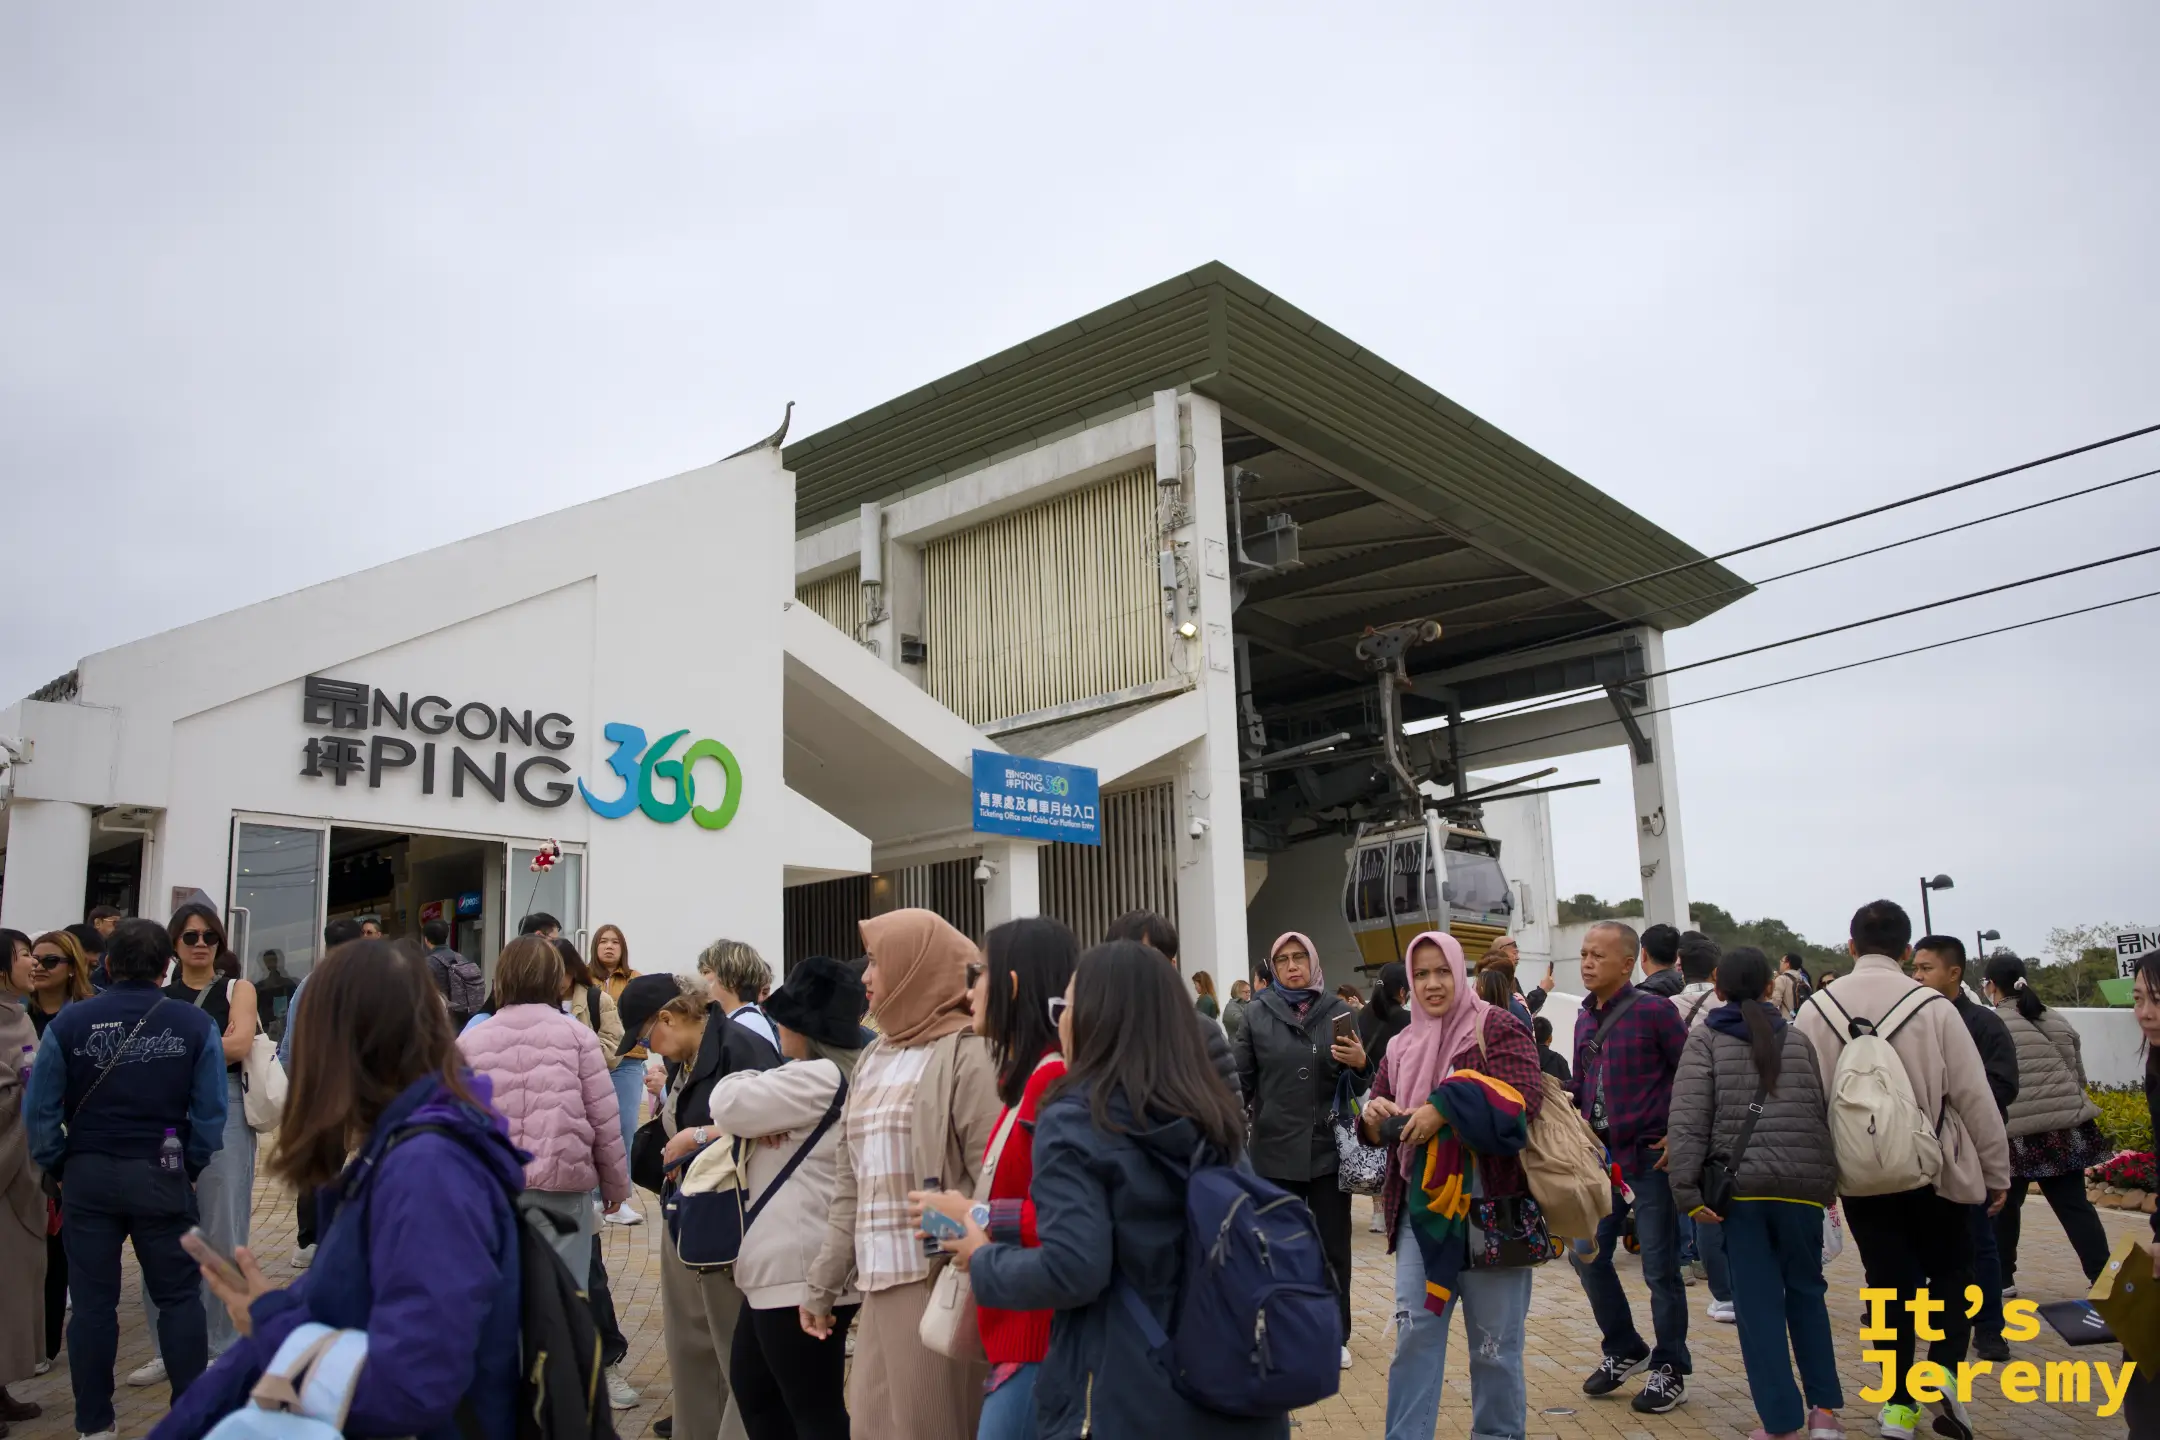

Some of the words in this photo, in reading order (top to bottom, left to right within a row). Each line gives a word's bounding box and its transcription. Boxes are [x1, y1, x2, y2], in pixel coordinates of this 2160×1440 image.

[372, 687, 575, 751] NGONG
[369, 735, 575, 808] PING
[578, 722, 743, 830] 360
[1014, 772, 1043, 782] NGONG
[1014, 779, 1043, 792] PING
[1042, 775, 1069, 796] 360
[979, 808, 1004, 821] Ticketing
[1004, 812, 1021, 823] Office
[1021, 814, 1032, 823] and
[1033, 815, 1049, 825] Cable
[1049, 817, 1060, 826] Car
[1060, 818, 1081, 829] Platform
[1081, 820, 1095, 832] Entry
[91, 1021, 123, 1030] SUPPORT
